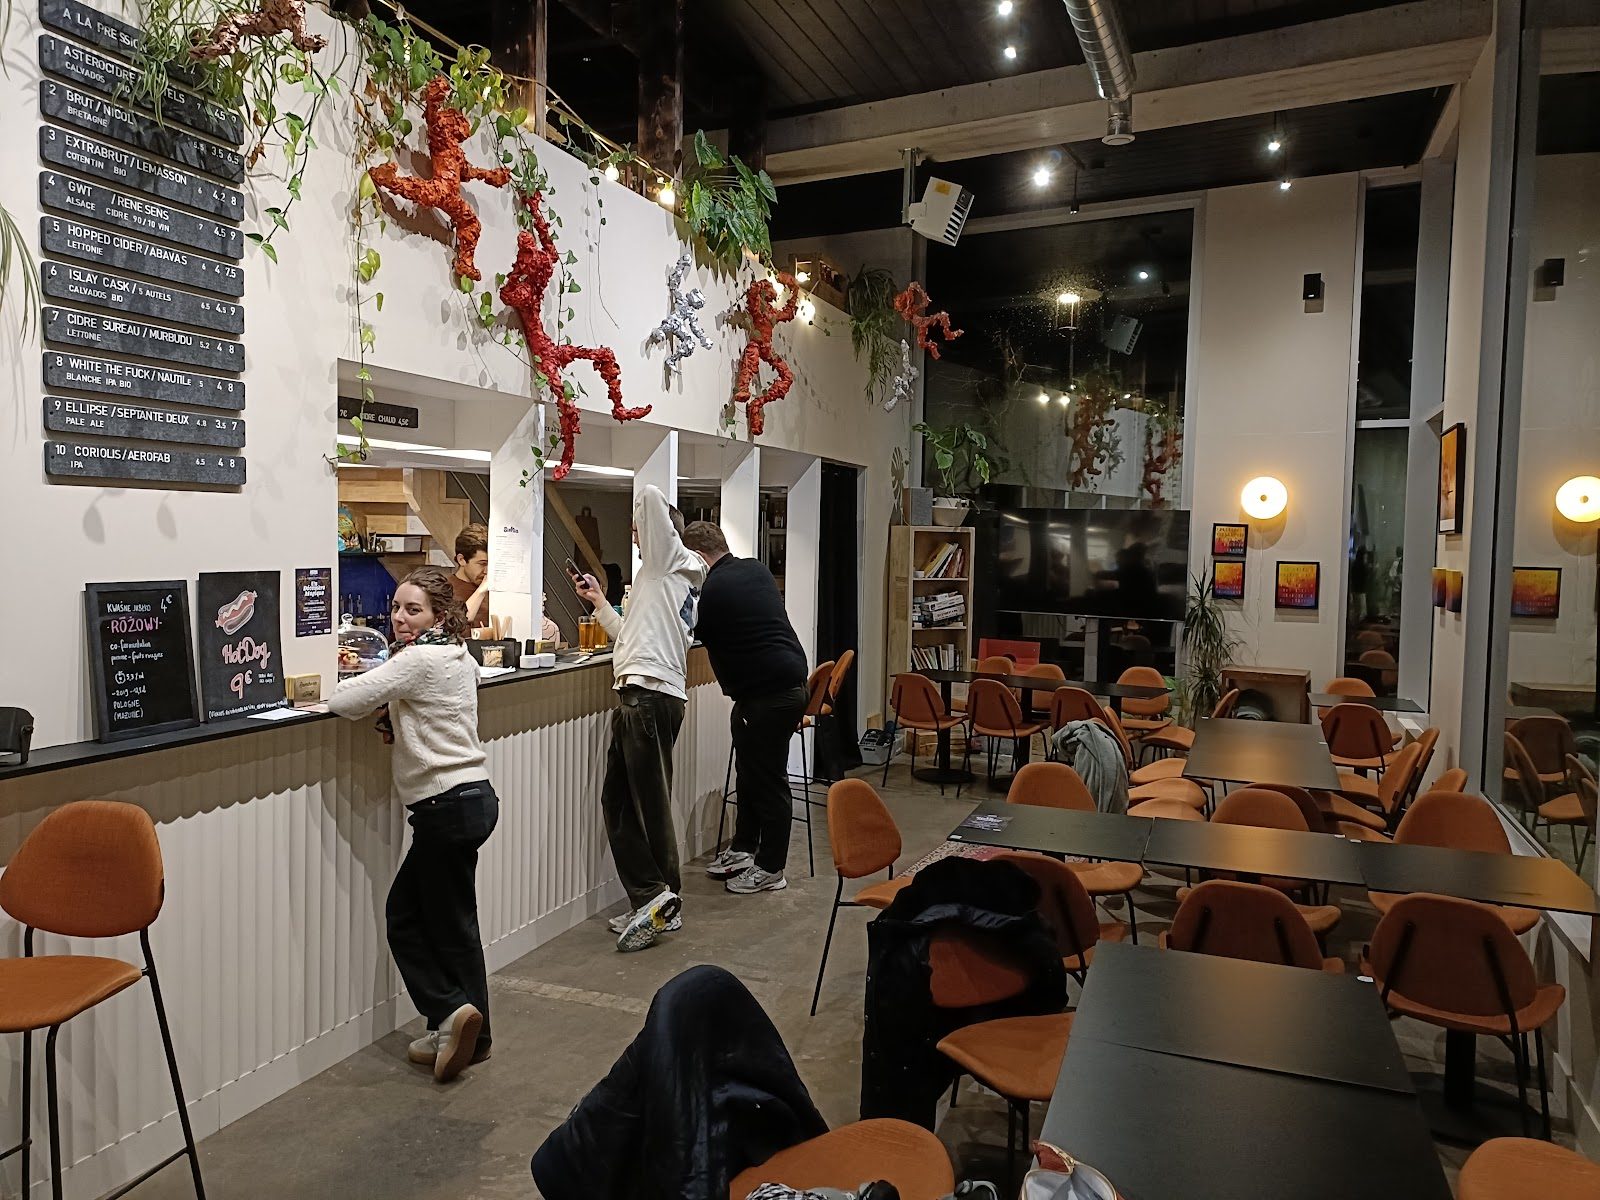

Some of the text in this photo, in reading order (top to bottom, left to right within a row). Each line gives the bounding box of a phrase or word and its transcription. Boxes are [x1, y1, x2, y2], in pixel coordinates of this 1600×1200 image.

[63, 8, 71, 20] A
[77, 13, 92, 29] LA
[50, 40, 55, 50] 1
[65, 61, 105, 84] CALVADOS
[49, 83, 56, 96] 2
[66, 90, 94, 110] BRUT
[67, 106, 108, 128] BRETAGNE
[49, 129, 56, 141] 3
[65, 134, 129, 166] EXTRABRUT
[136, 161, 187, 186] LEMASSON
[212, 190, 226, 203] 4.2
[231, 196, 237, 206] 8
[66, 151, 127, 177] COTENTIN BIO
[48, 175, 55, 186] 4
[68, 181, 92, 197] GWT
[144, 203, 170, 221] SENS
[199, 223, 204, 231] 7
[230, 231, 236, 241] 9
[65, 195, 170, 233] ALSACE CIDRE 90/10 VIN
[53, 221, 60, 232] 5
[67, 224, 111, 245] HOPPED
[202, 263, 206, 271] 6
[215, 265, 221, 274] 4
[67, 239, 103, 256] LETTONIE
[50, 265, 57, 277] 6
[69, 268, 98, 285] ISLAY
[102, 277, 130, 293] CASK
[145, 290, 172, 302] AUTELS
[216, 303, 227, 314] 4.5
[230, 306, 236, 316] 9
[68, 284, 123, 303] CALVADOS BIO
[52, 310, 59, 321] 7
[67, 313, 98, 329] CIDRE
[102, 320, 140, 336] SUREAU
[200, 341, 210, 350] 5.2
[217, 343, 222, 351] 4
[229, 344, 235, 354] 8
[66, 328, 101, 341] LETTONIE
[56, 356, 63, 367] 8
[68, 357, 102, 373] WHITE
[104, 363, 123, 376] THE
[157, 371, 192, 386] NAUTILE
[200, 380, 204, 388] 5
[217, 382, 222, 391] 4
[228, 383, 234, 393] 8
[66, 372, 132, 390] BLANCHE IPA BIO
[54, 400, 61, 411] 9
[65, 401, 108, 416] ELLIPSE
[165, 413, 189, 425] DEUX
[215, 419, 226, 429] 3.5
[232, 421, 238, 431] 7
[65, 416, 105, 429] PALE ALE
[377, 414, 396, 424] CHAUD
[55, 444, 66, 456] 10
[218, 457, 223, 467] 4
[229, 458, 235, 468] 8
[70, 460, 84, 469] IPA
[113, 699, 140, 710] POLOGNE
